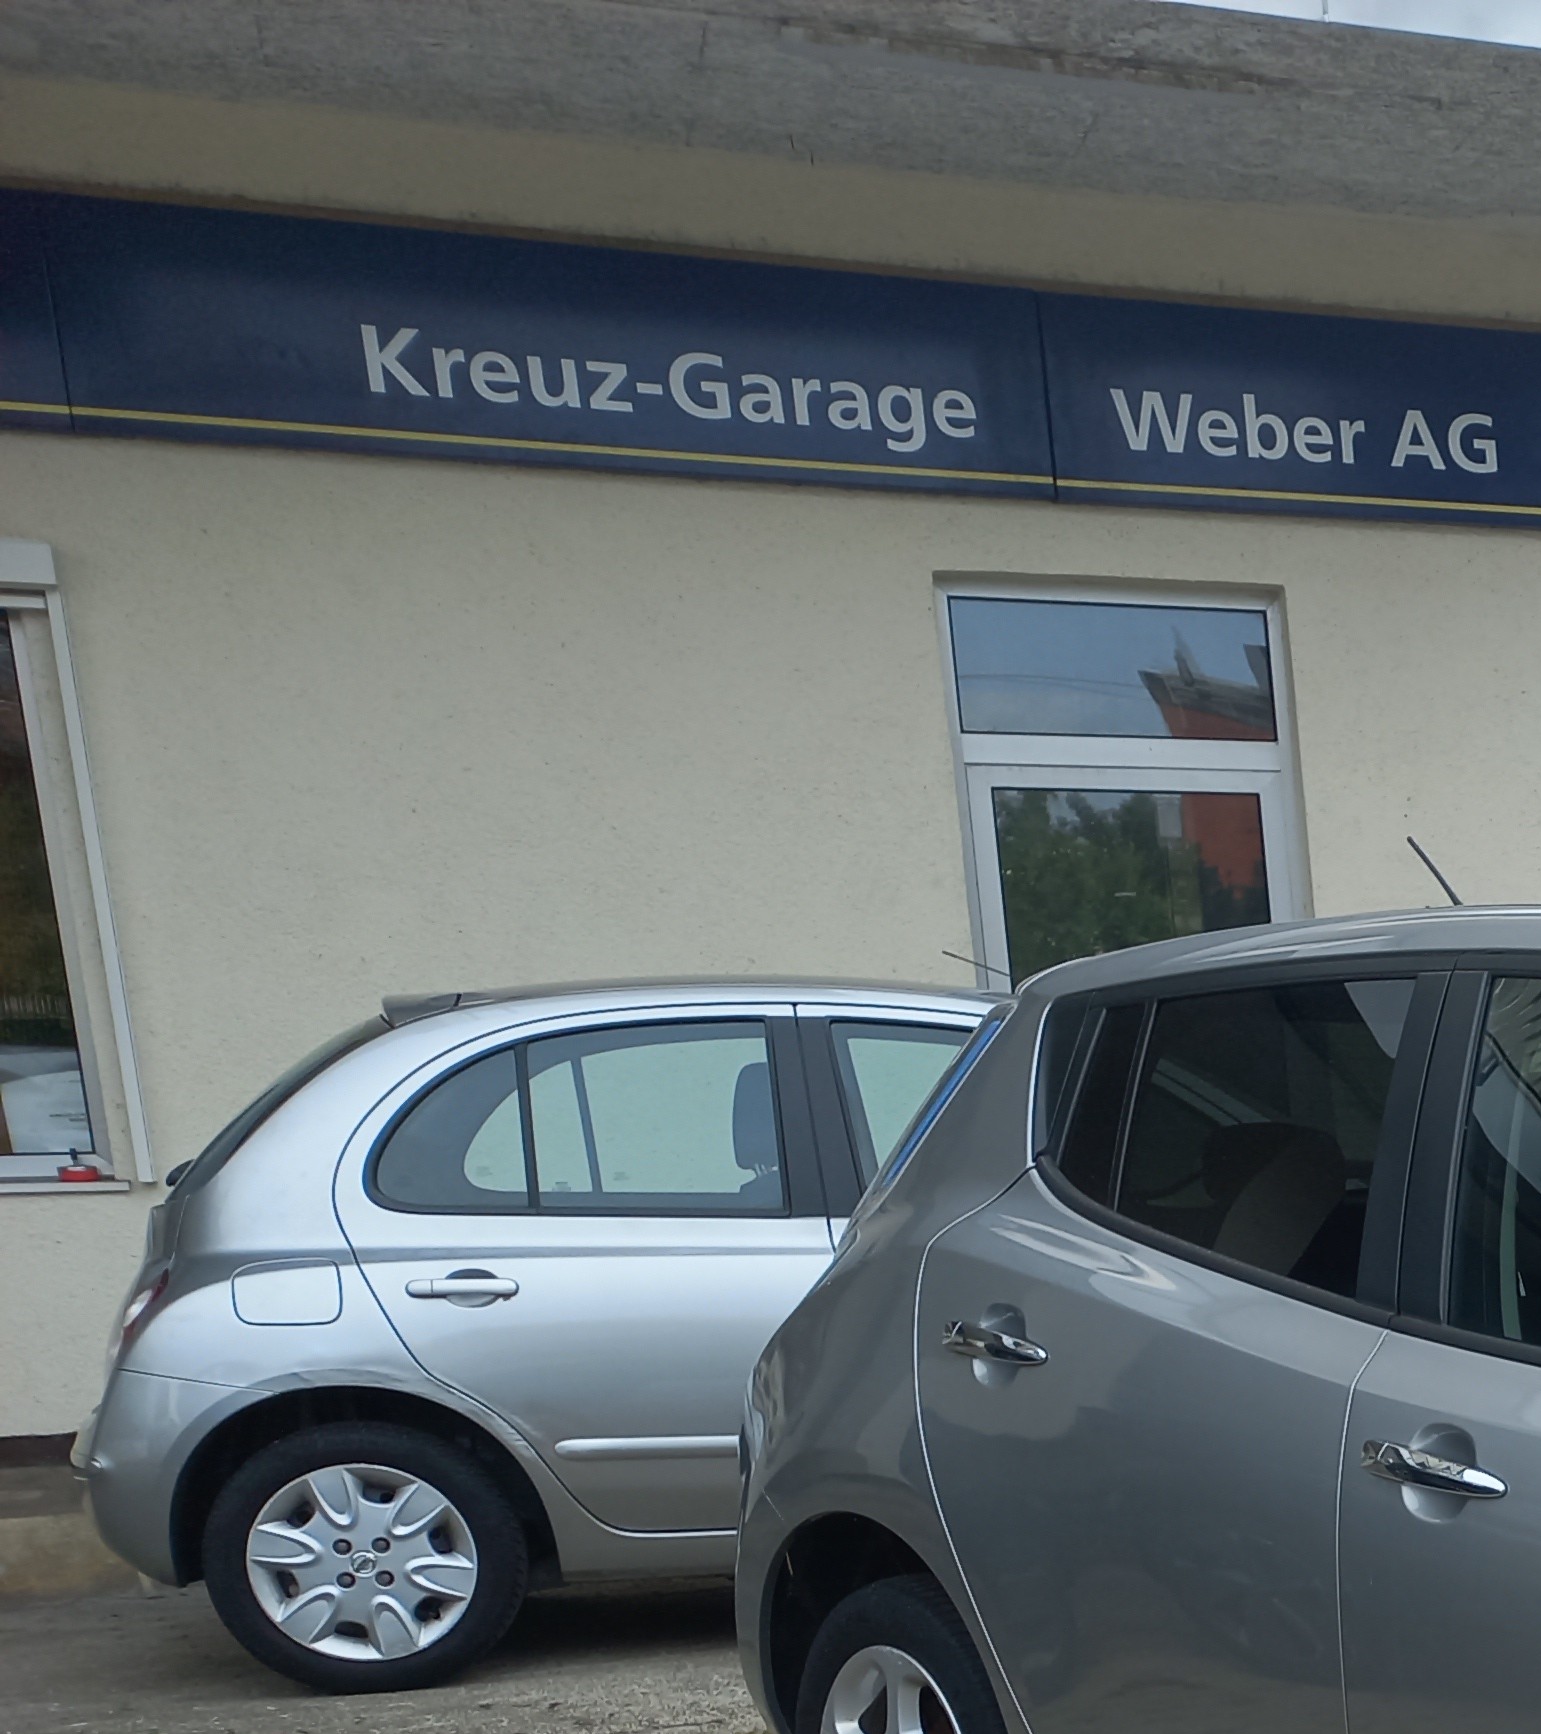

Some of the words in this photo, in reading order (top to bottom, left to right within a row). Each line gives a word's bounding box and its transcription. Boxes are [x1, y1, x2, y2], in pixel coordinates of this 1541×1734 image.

[360, 323, 977, 452] Kreuz-Garage
[1110, 388, 1365, 465] Weber
[1390, 409, 1498, 474] AG
